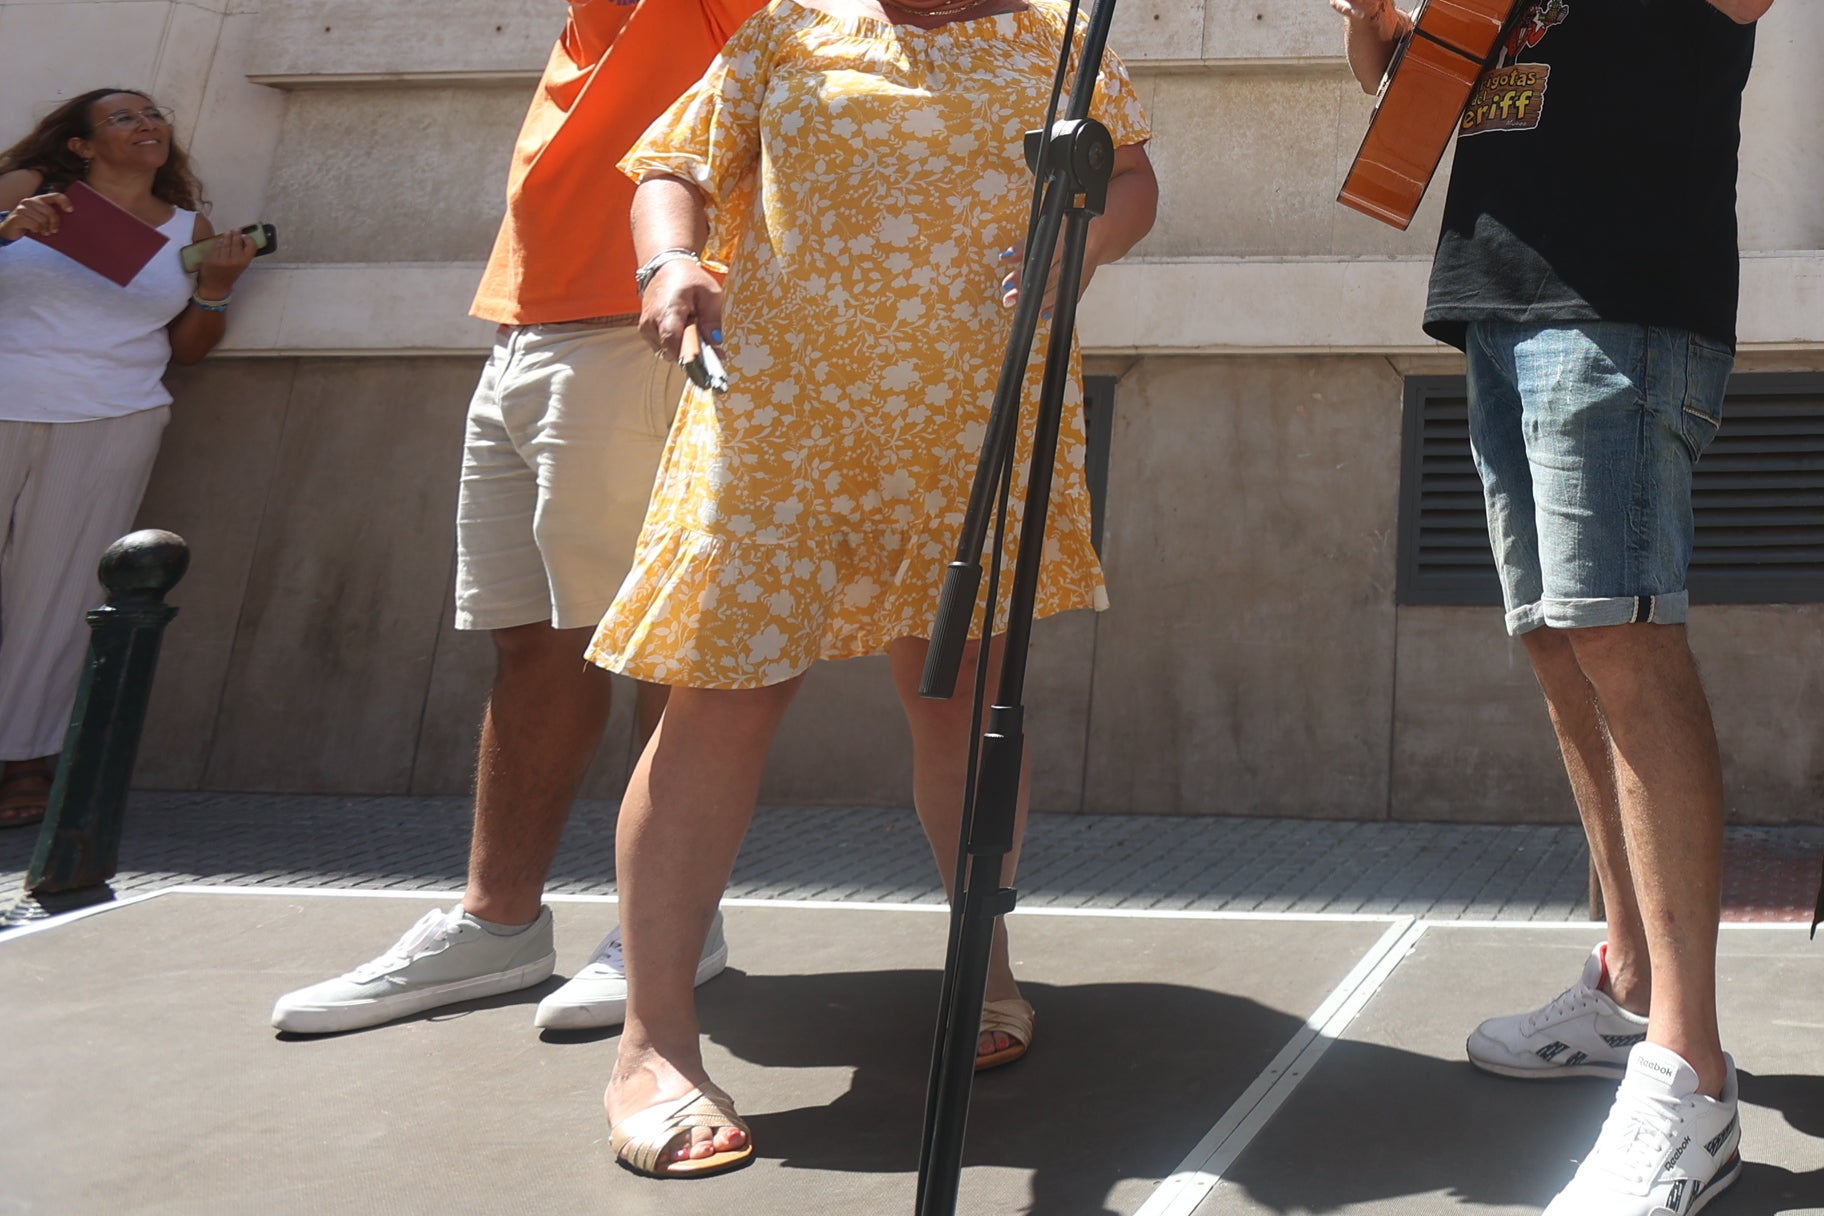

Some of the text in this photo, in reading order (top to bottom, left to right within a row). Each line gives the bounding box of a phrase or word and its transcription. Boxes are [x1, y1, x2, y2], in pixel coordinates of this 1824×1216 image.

[1462, 90, 1533, 129] eriff
[1637, 1055, 1673, 1078] Reebok
[1664, 1135, 1692, 1172] Reebok
